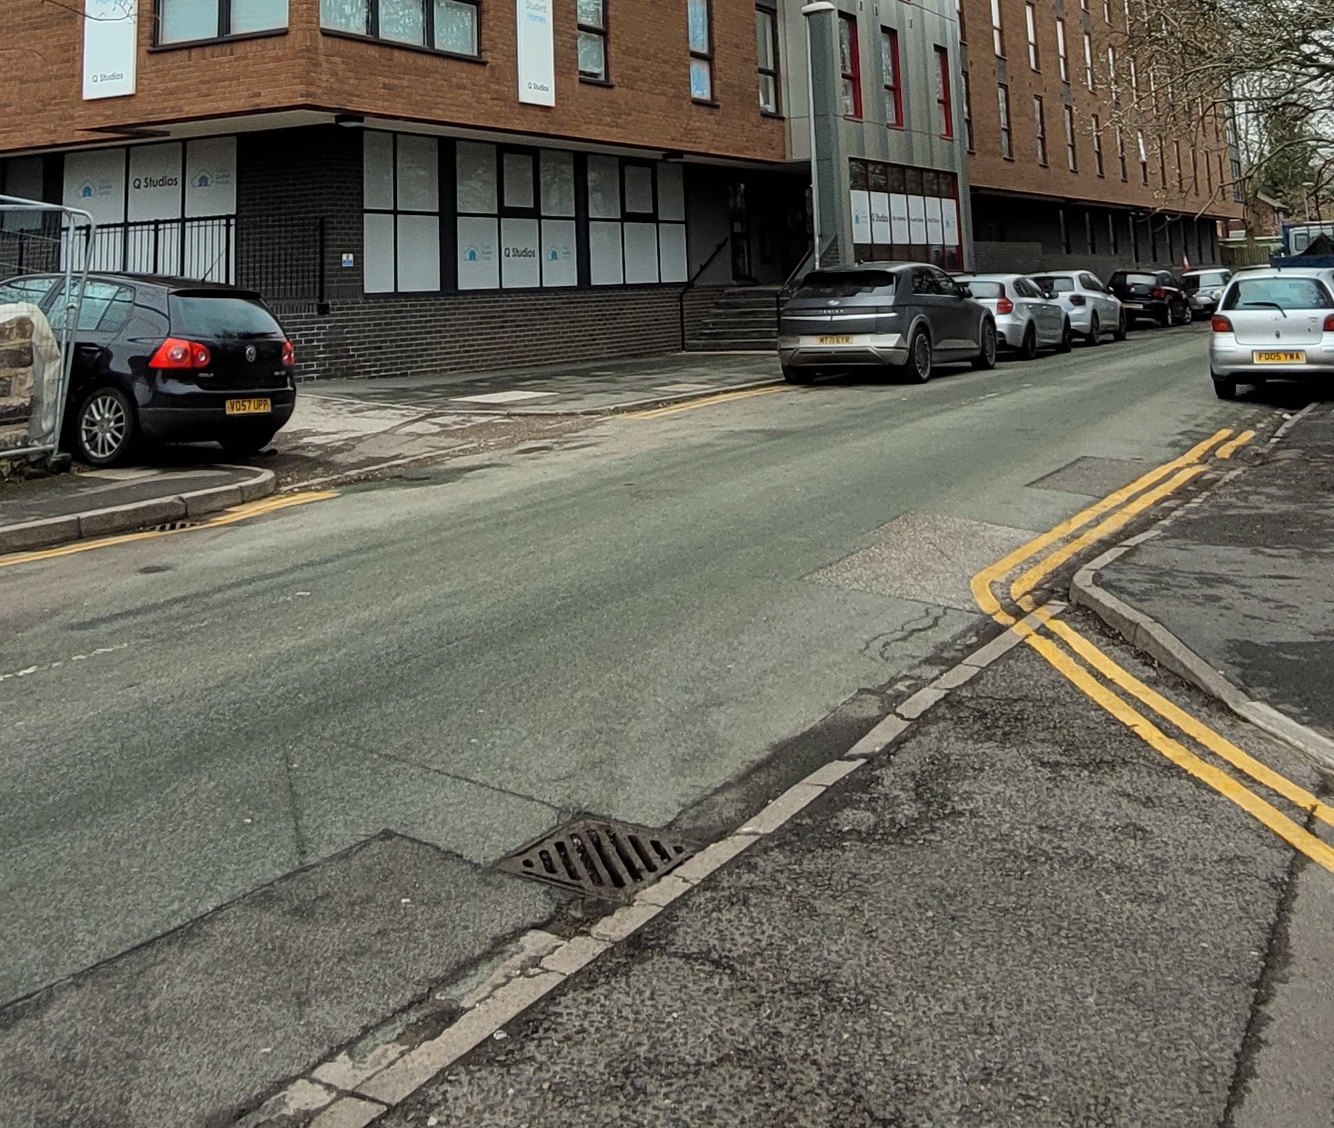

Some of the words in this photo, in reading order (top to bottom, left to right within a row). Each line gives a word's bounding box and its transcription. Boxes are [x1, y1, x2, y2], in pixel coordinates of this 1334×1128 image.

[525, 0, 547, 13] Student
[92, 74, 98, 83] Q
[100, 72, 124, 82] Studios
[533, 82, 549, 92] Studios
[133, 178, 141, 189] Q
[143, 176, 178, 189] Studios
[504, 247, 510, 258] Q
[512, 247, 535, 258] Studios
[229, 400, 252, 412] VO57
